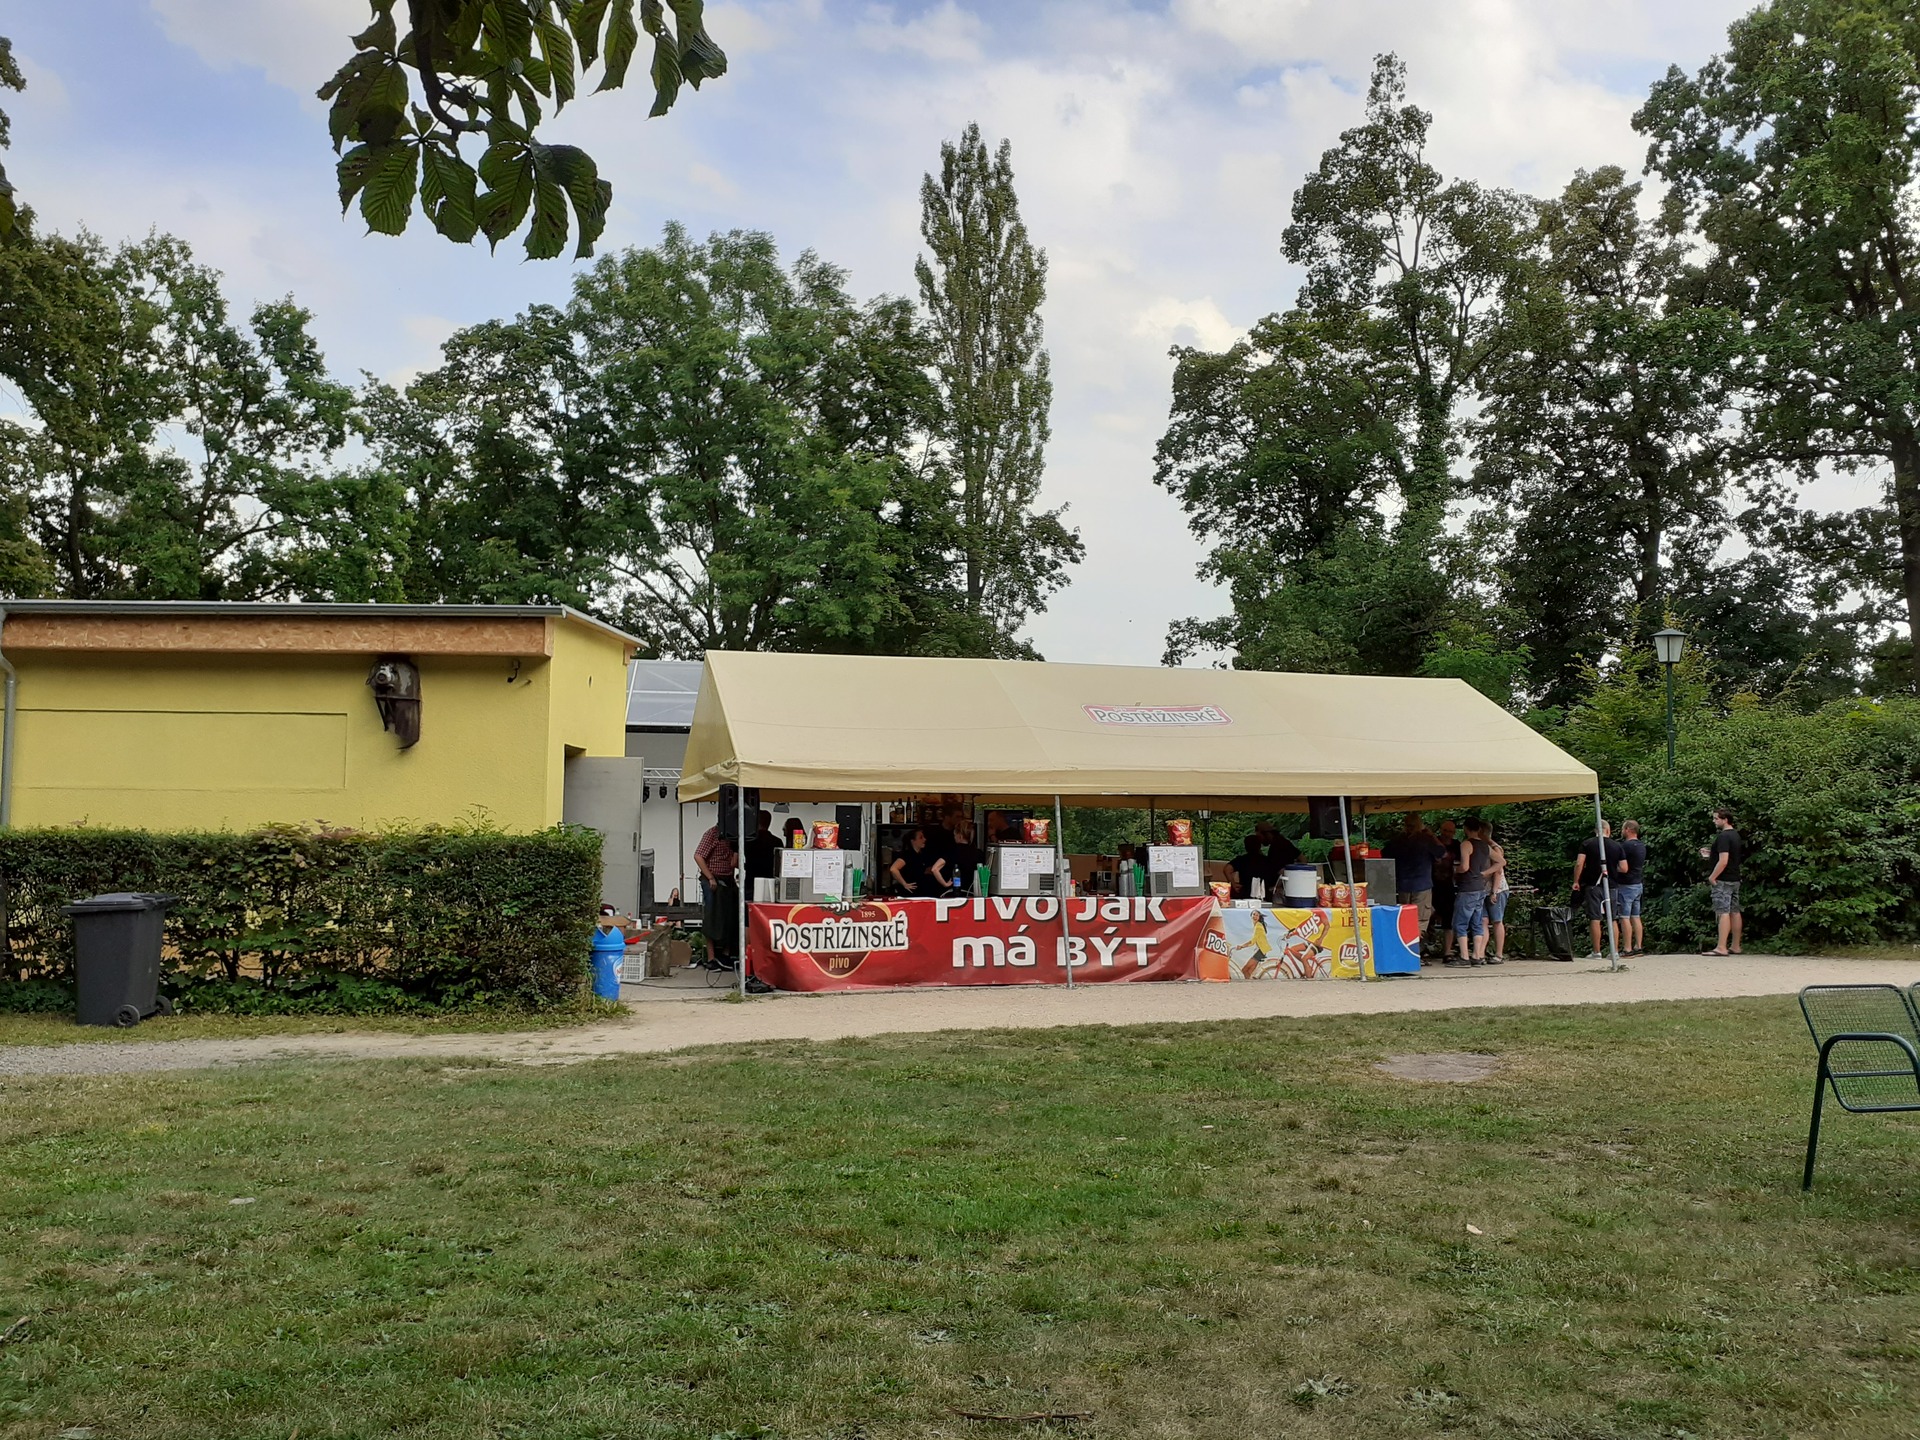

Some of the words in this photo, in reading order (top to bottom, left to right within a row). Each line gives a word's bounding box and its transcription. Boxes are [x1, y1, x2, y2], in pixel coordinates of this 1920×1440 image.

[772, 913, 906, 950] POSTŘIŽINSKÉ
[952, 924, 1037, 967] má
[1056, 926, 1158, 967] BÝT
[828, 954, 850, 971] pivo
